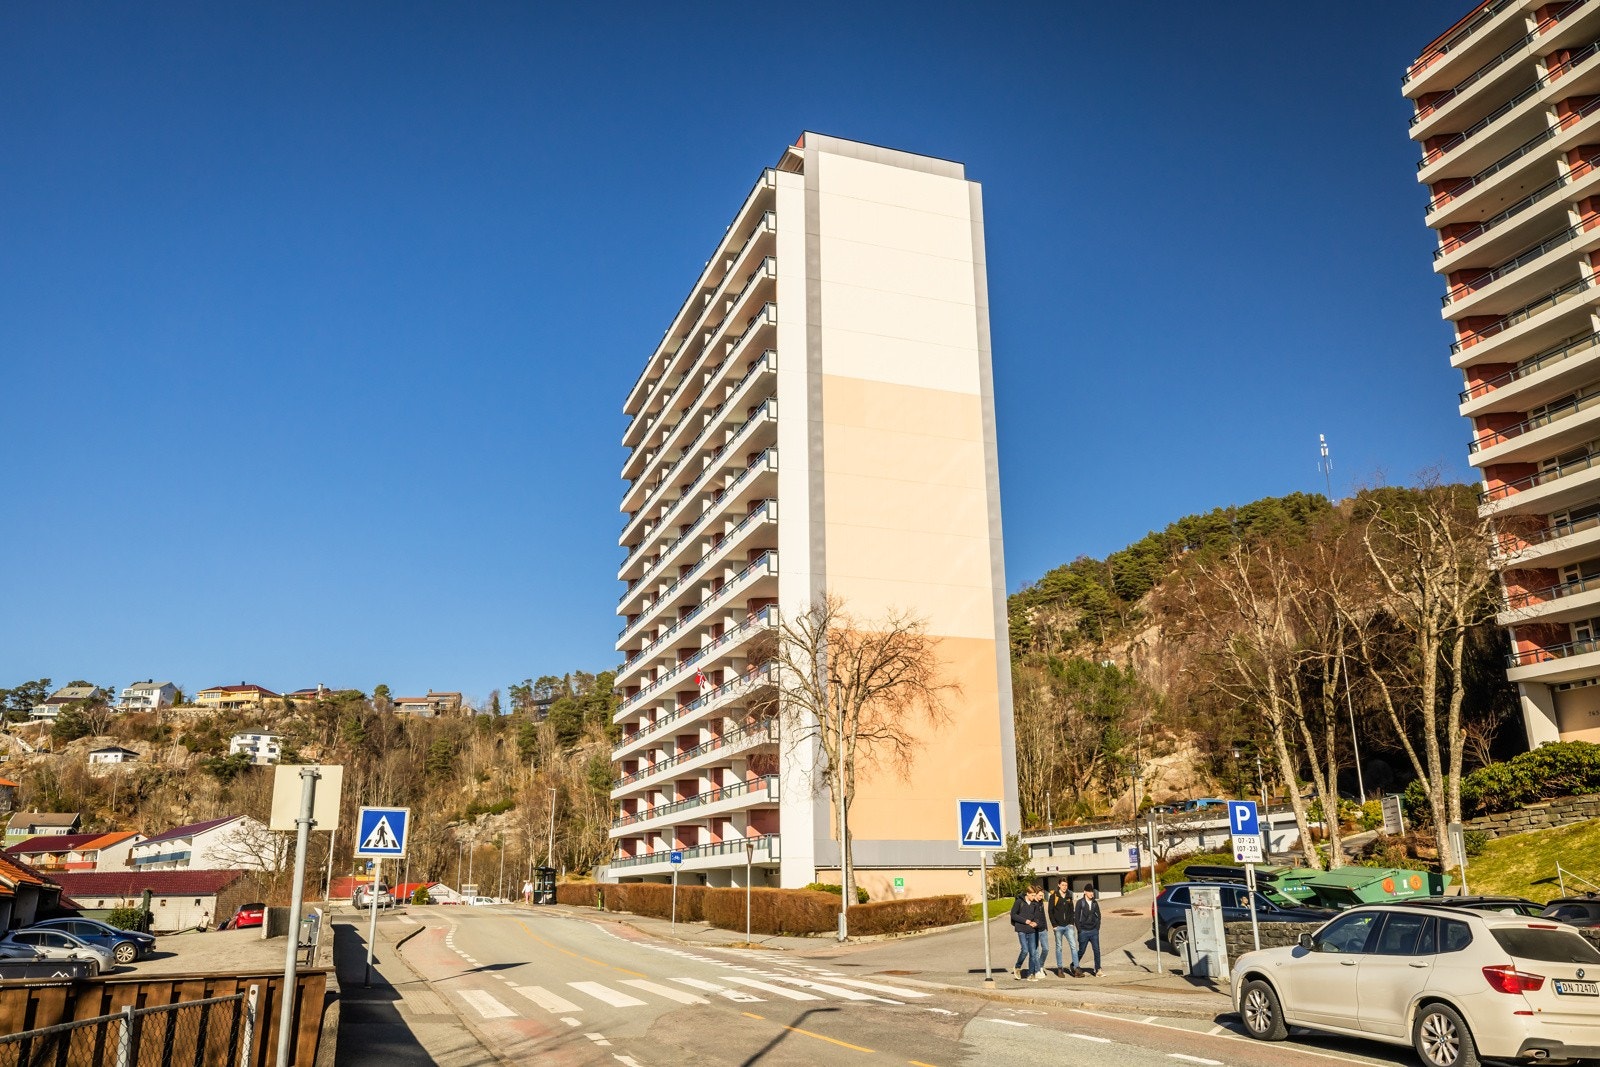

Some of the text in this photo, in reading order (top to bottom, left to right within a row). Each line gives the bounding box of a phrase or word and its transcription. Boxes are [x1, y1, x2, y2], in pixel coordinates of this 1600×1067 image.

[1235, 805, 1251, 831] P
[1562, 982, 1597, 994] DN 72470
